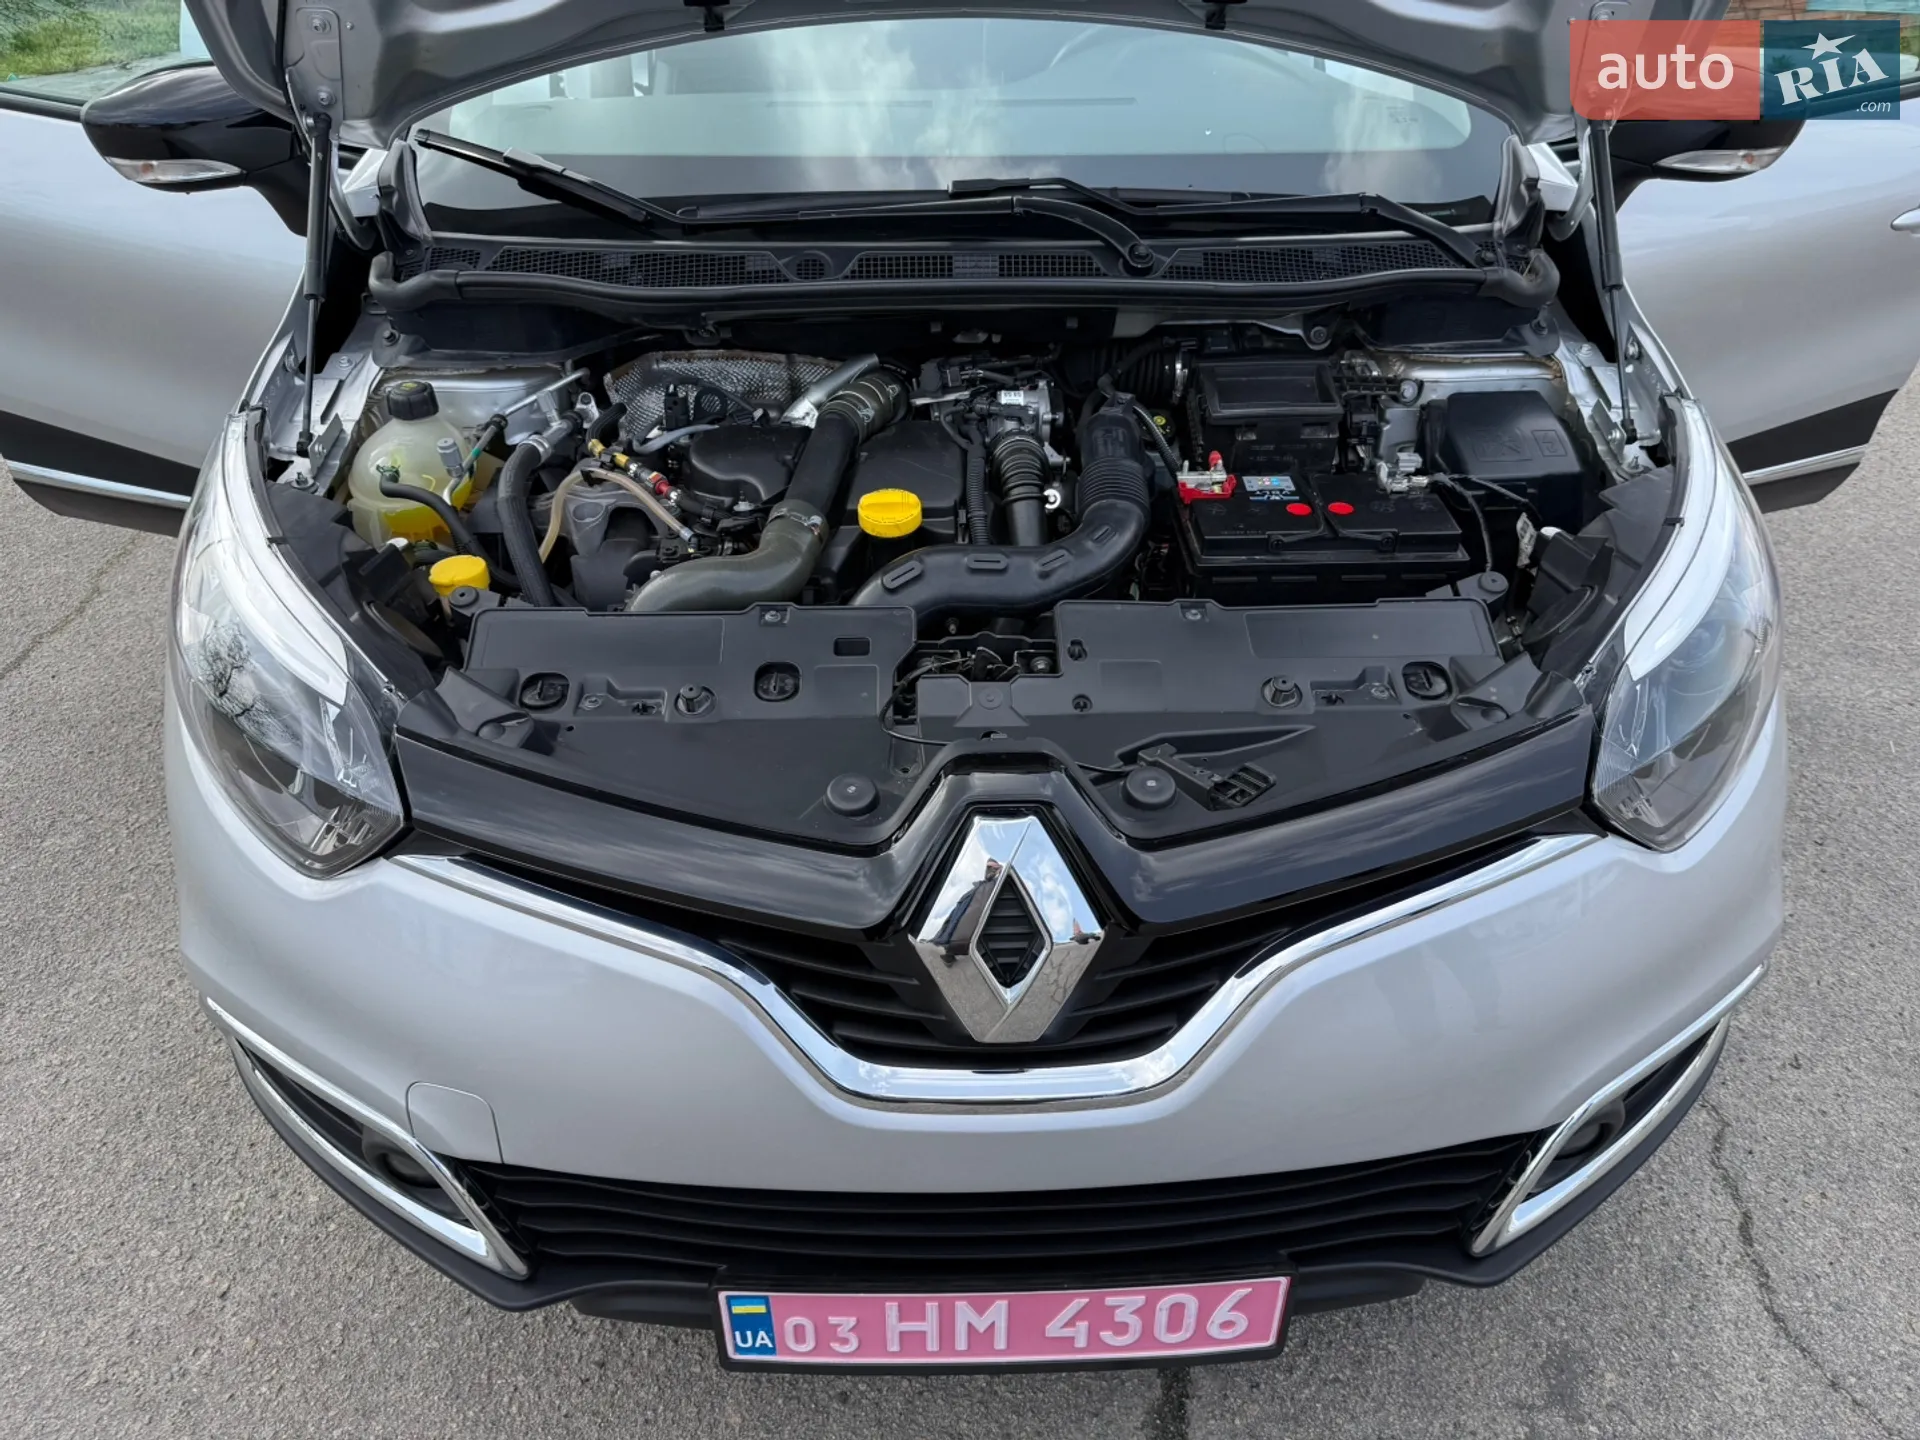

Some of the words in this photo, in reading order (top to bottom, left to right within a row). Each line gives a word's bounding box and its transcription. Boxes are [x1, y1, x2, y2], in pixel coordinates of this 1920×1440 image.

[734, 1330, 774, 1350] UA
[783, 1316, 860, 1353] 03
[885, 1299, 1008, 1352] HM
[1044, 1287, 1253, 1349] 4306
